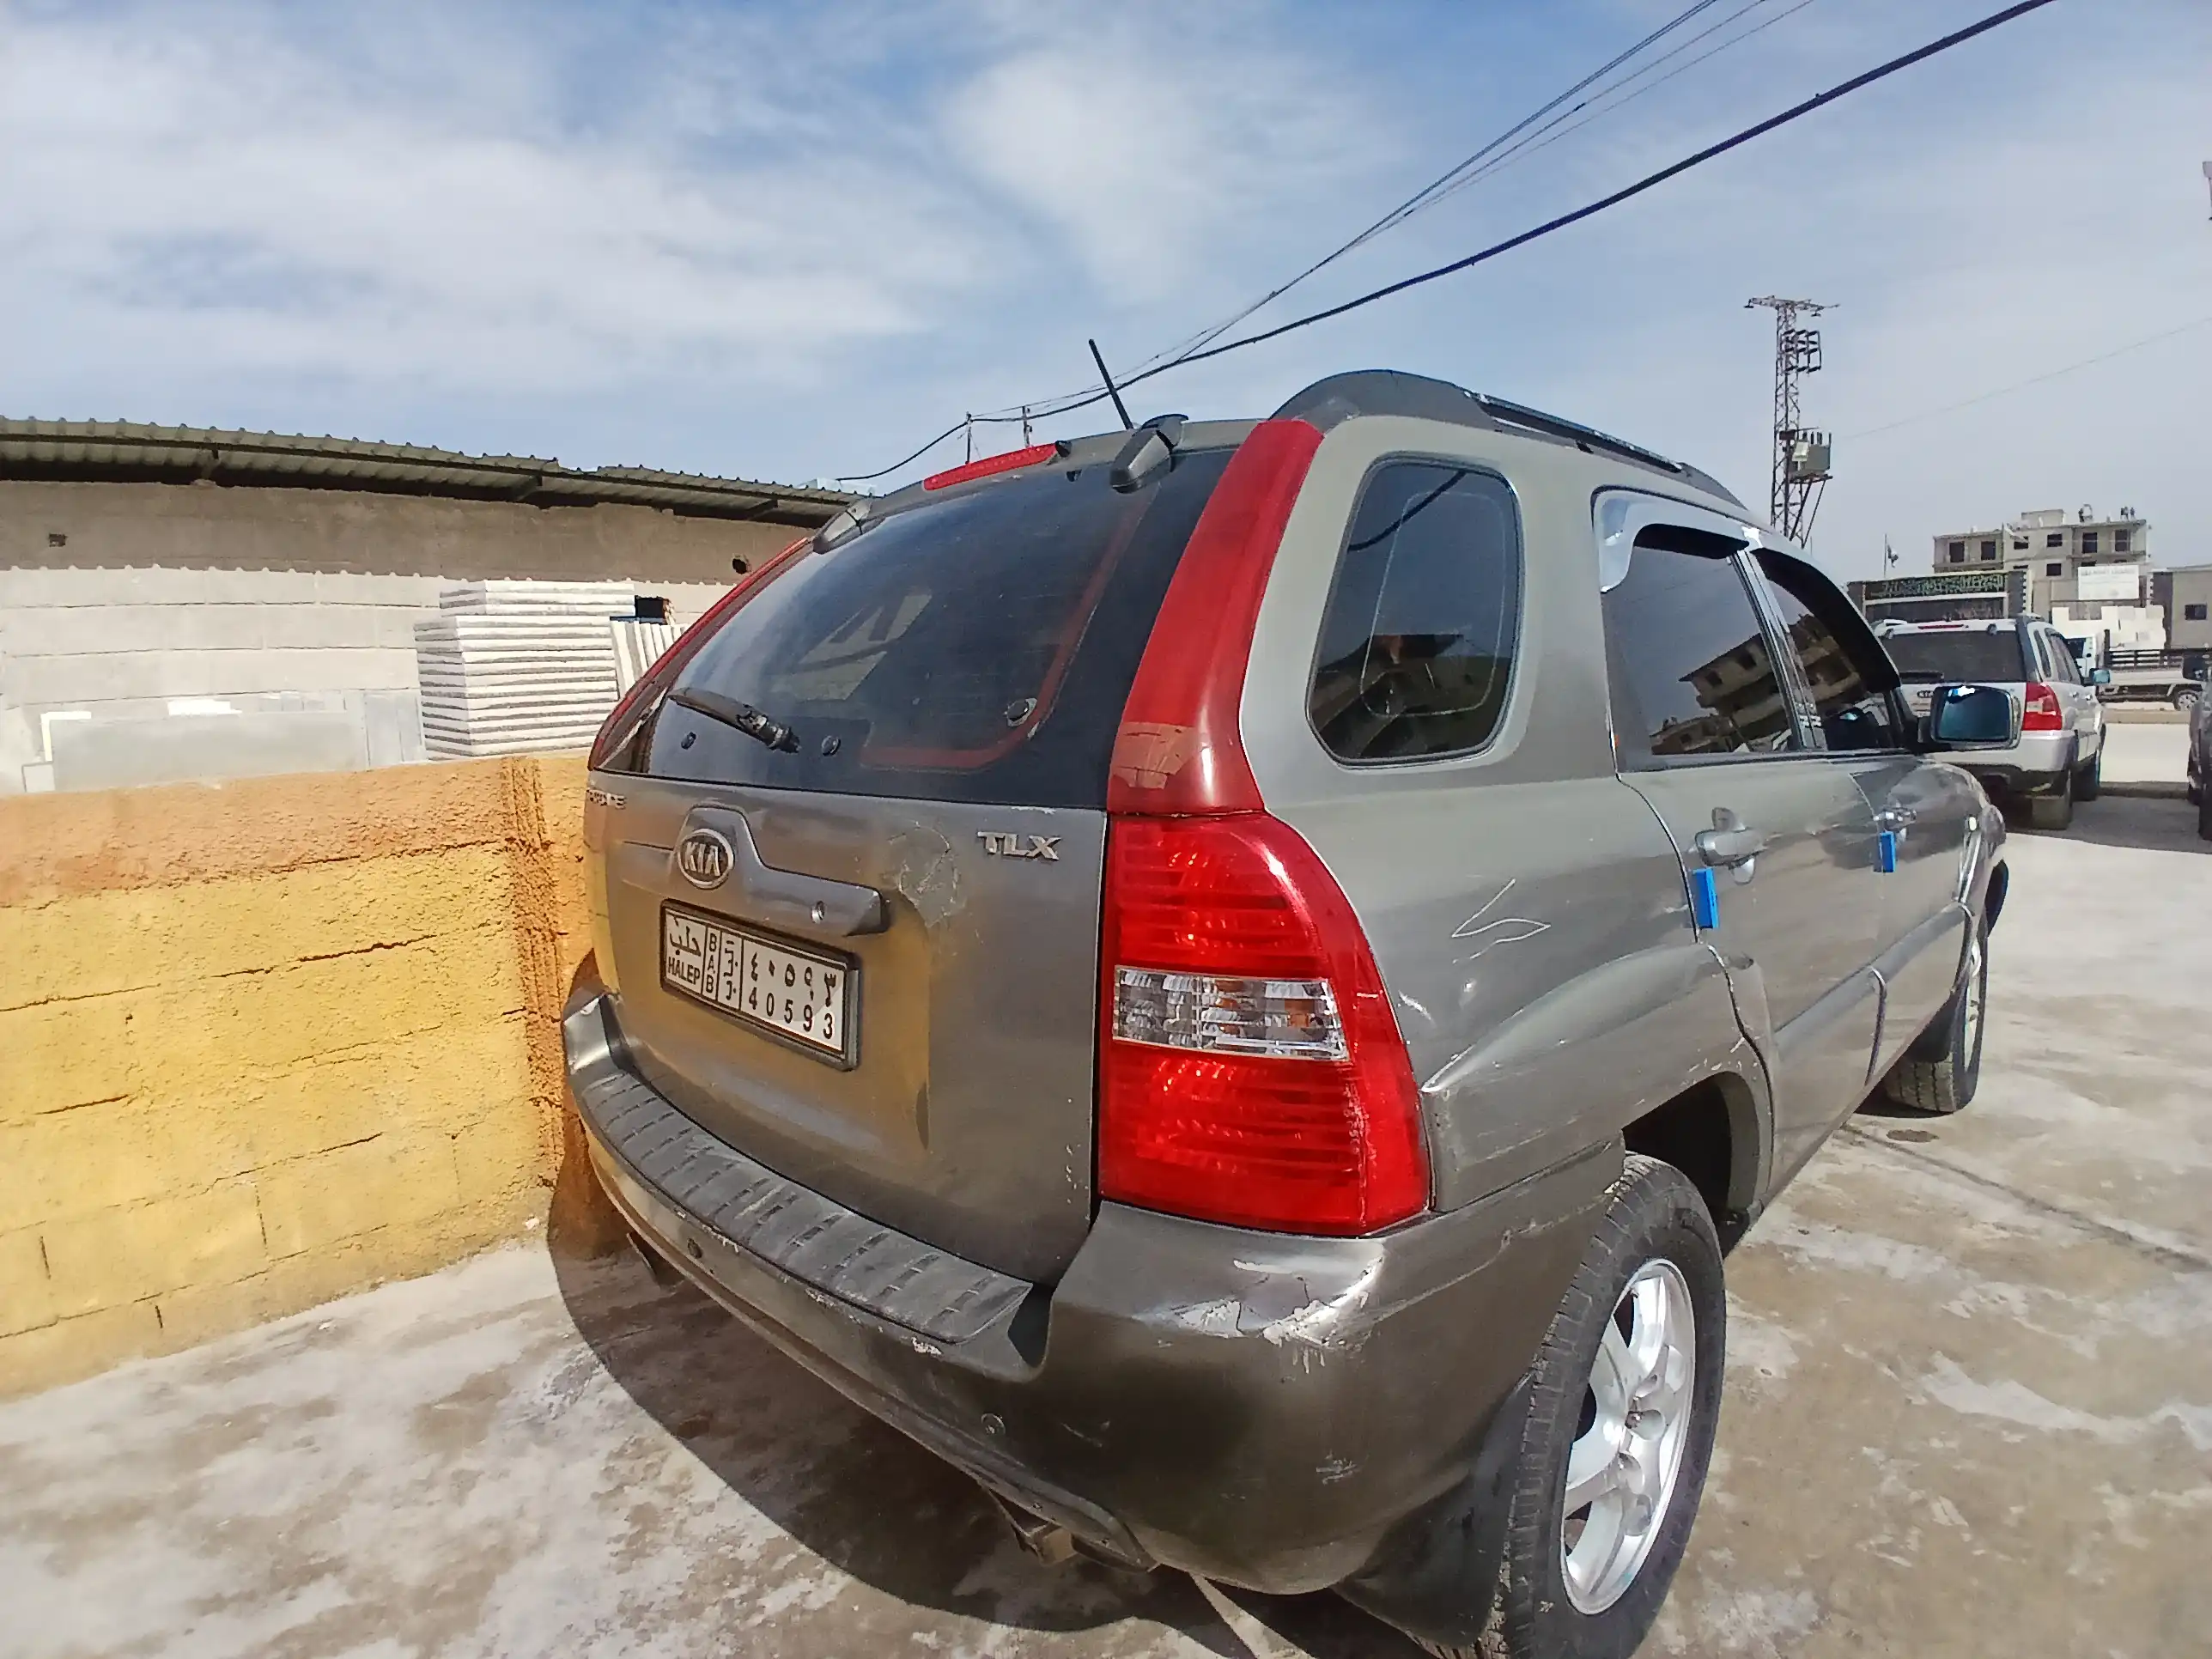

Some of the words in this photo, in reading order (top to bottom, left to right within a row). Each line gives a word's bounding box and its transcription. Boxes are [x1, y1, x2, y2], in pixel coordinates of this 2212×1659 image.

[684, 842, 720, 877] KIA
[977, 831, 1062, 860] TLX
[669, 926, 702, 957] حلب
[667, 956, 701, 986] HALEP
[748, 986, 834, 1040] 40593
